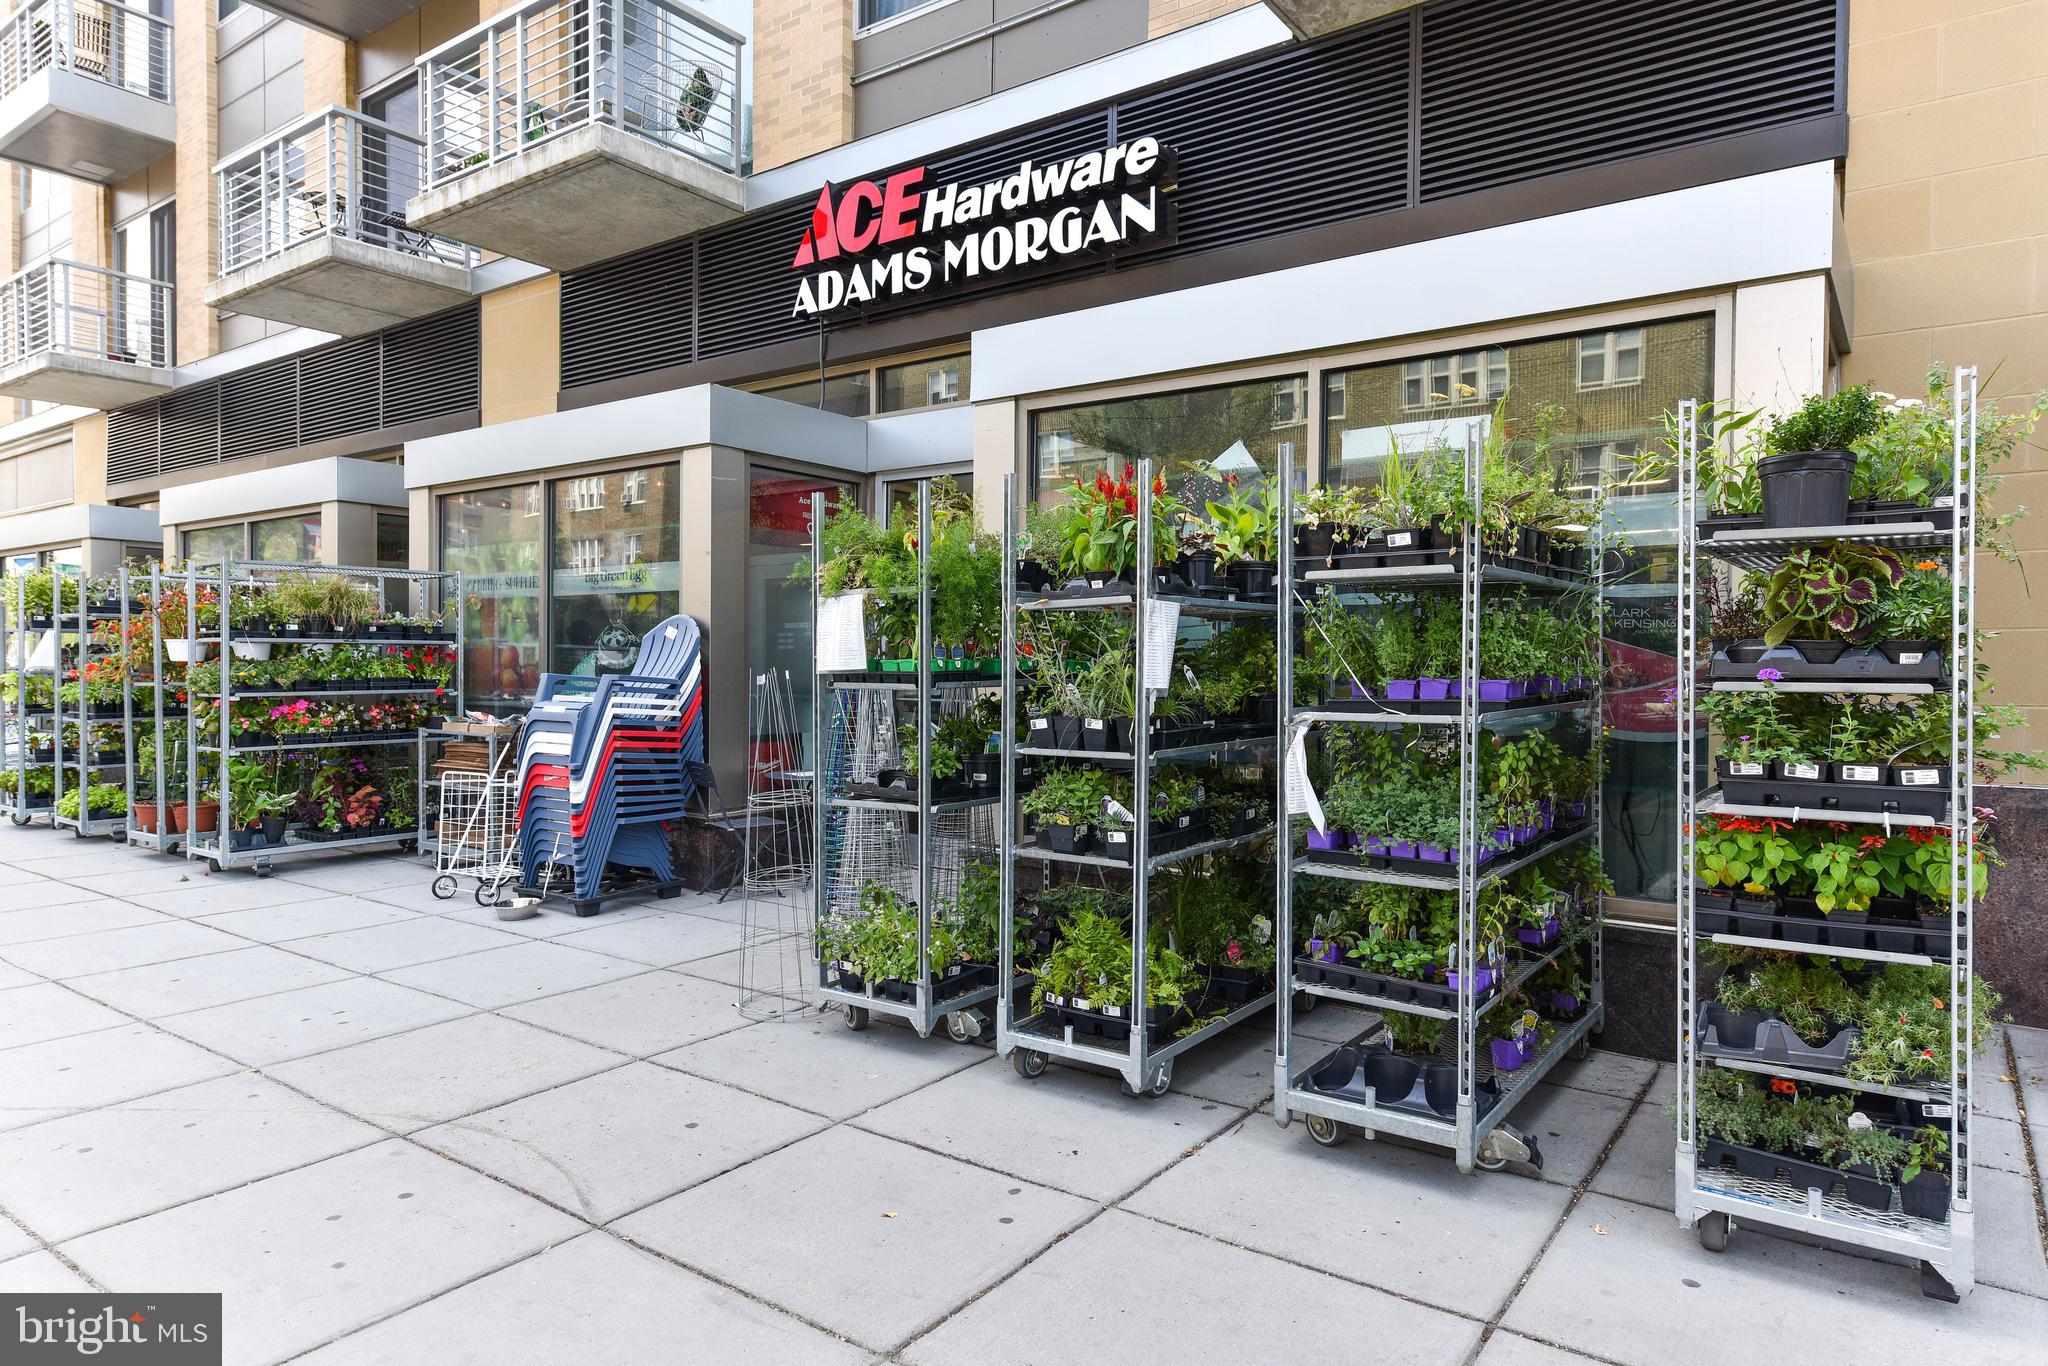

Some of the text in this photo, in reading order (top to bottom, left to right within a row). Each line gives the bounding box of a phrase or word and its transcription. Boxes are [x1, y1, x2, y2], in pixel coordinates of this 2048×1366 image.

[791, 136, 1159, 269] ACE Hardware
[792, 186, 1156, 317] ADAMS MORGAN
[799, 496, 811, 505] Ace
[504, 575, 540, 590] SUPPLIE
[584, 567, 648, 585] Big Green Egg
[1606, 607, 1651, 618] LARK
